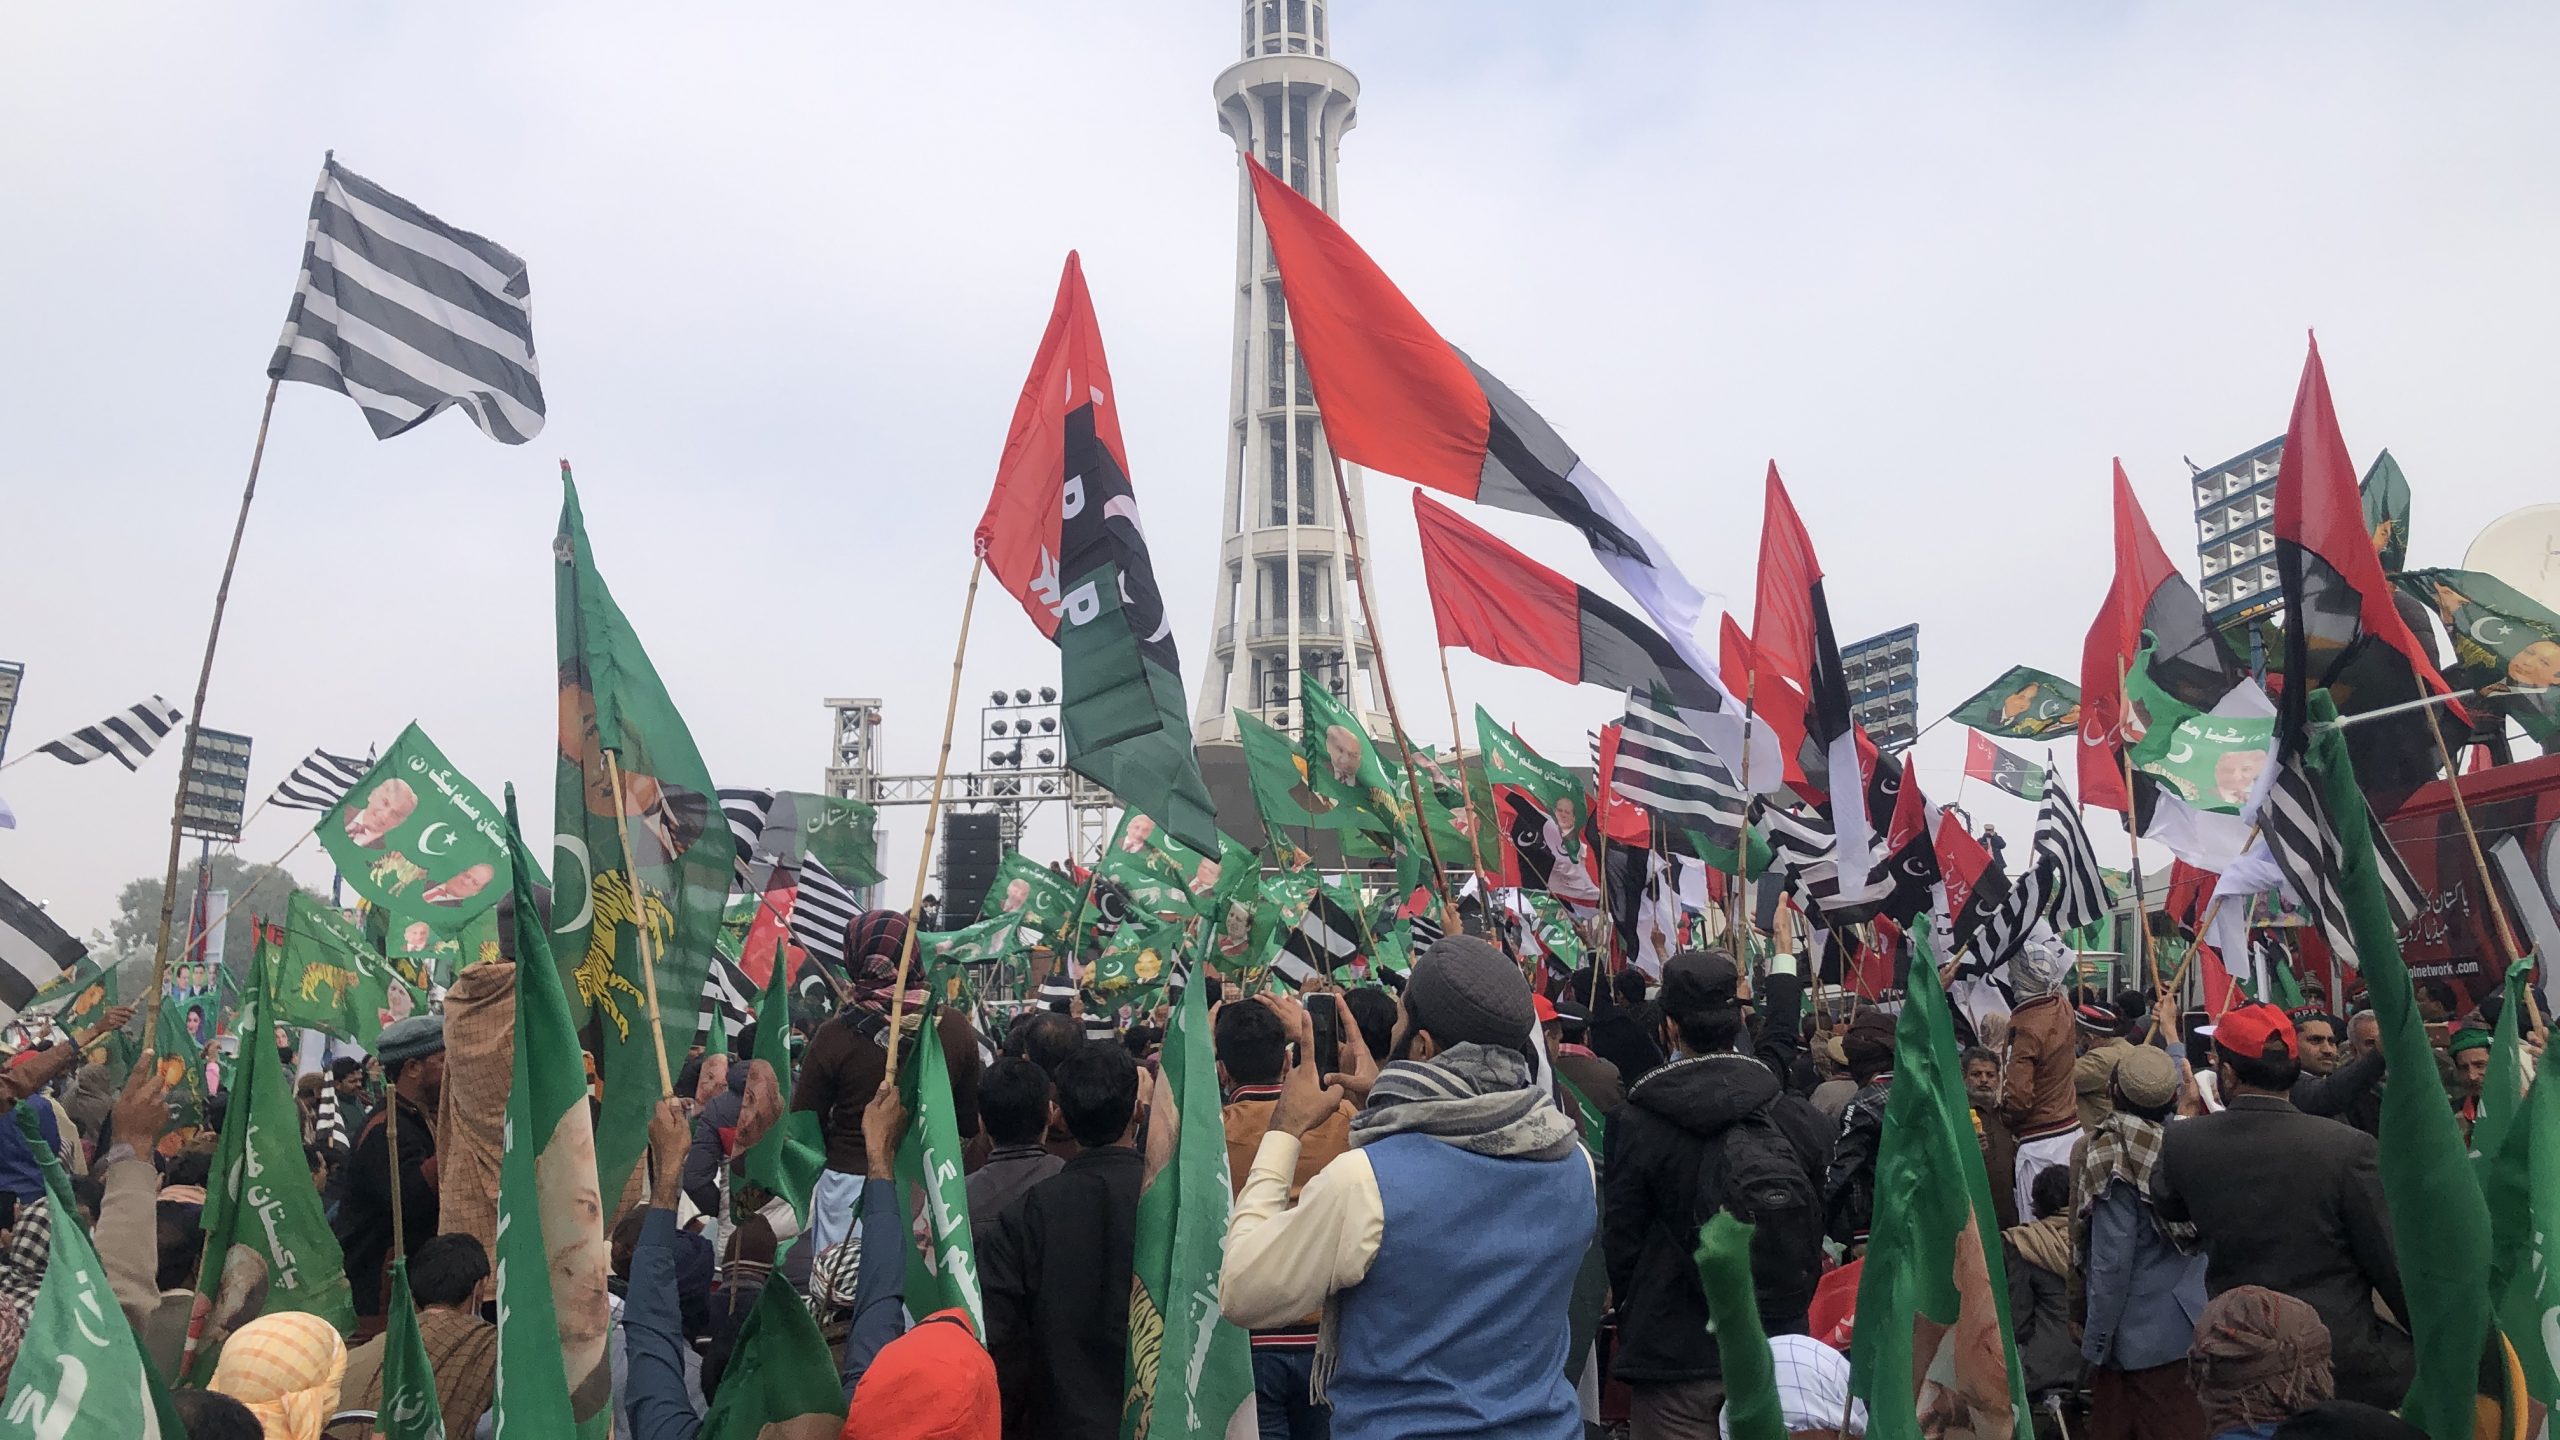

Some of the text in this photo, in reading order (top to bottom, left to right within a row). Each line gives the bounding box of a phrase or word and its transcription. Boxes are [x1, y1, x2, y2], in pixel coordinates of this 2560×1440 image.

[428, 768, 460, 796] لیگ
[449, 793, 481, 821] مسلم
[245, 1113, 299, 1290] پاکستان مسل
